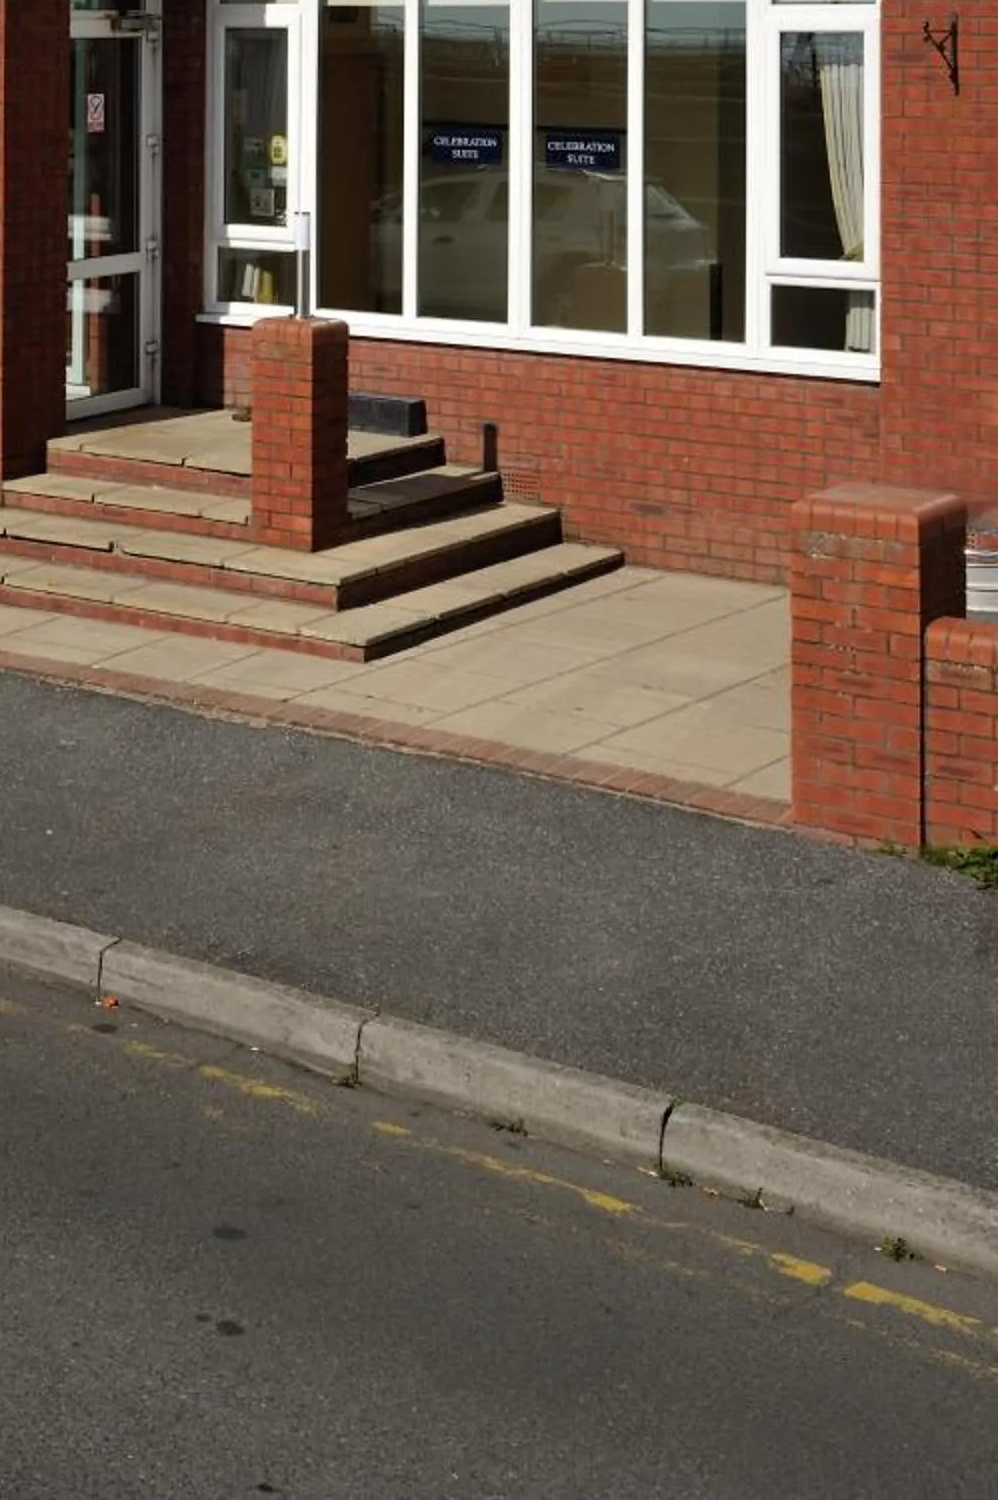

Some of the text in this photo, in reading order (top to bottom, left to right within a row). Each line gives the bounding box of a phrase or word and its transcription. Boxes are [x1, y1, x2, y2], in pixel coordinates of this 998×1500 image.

[433, 135, 498, 148] CELEBRATION
[547, 140, 616, 153] CELEBRATION
[452, 148, 479, 160] SUITE
[566, 153, 596, 165] SUITE
